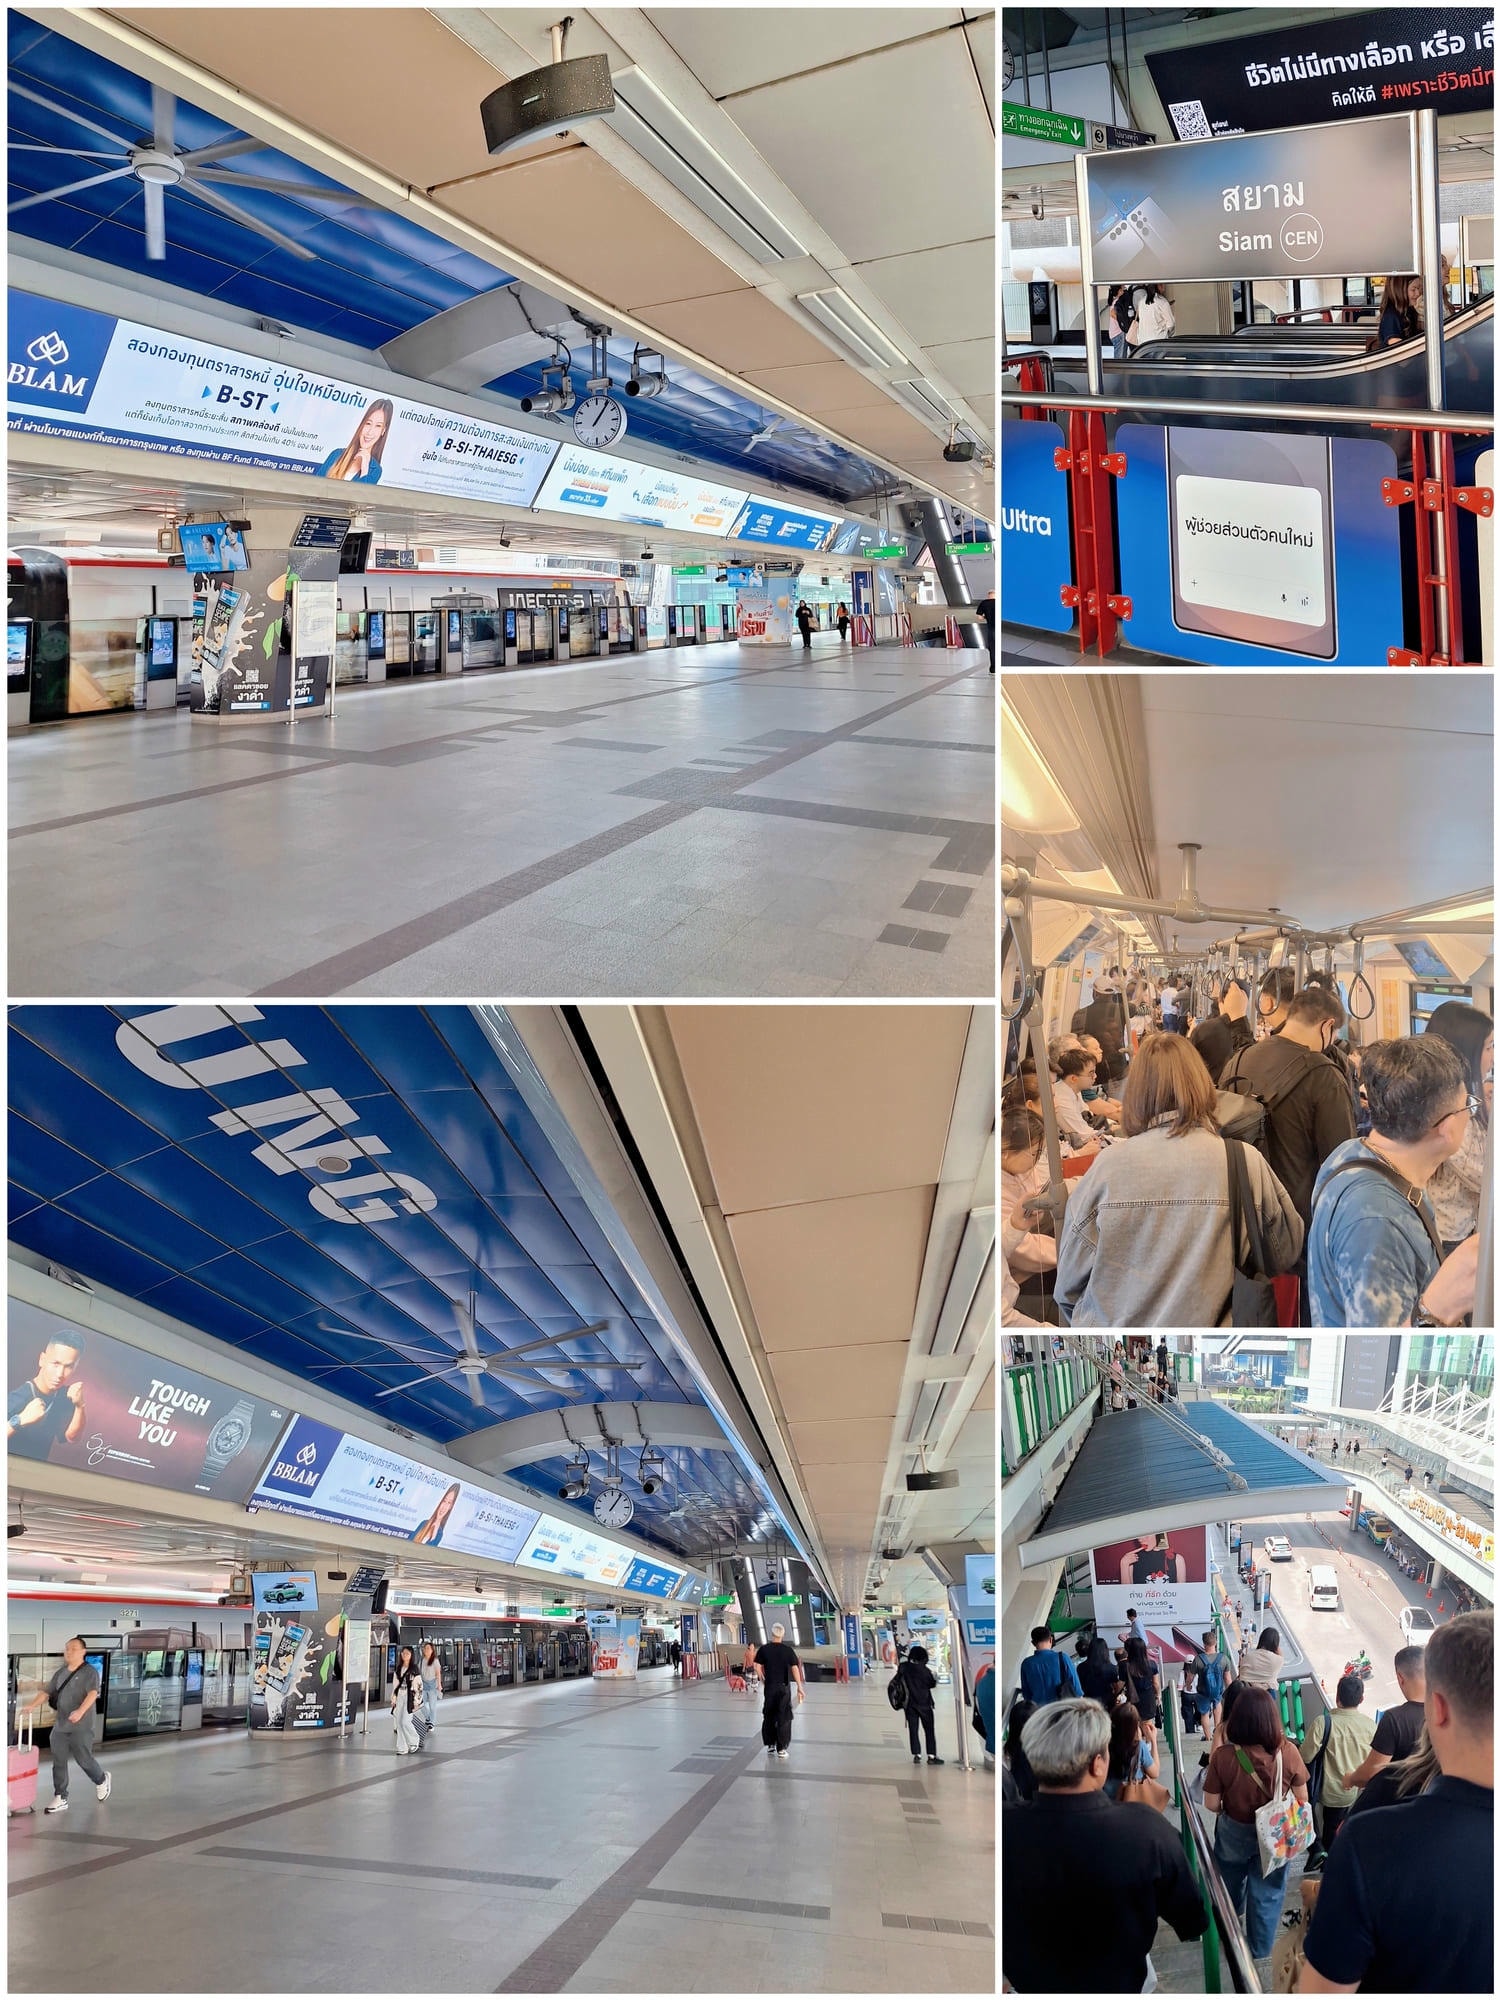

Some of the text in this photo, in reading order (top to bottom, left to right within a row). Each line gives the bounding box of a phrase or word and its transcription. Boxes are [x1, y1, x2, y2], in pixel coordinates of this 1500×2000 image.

[1245, 41, 1413, 87] ชีวิตไม่มีทางเลือก
[1421, 28, 1466, 59] หรือ
[1332, 85, 1377, 107] คิดให้ดี
[1020, 124, 1062, 139] Emergency Exit
[1096, 130, 1102, 142] 3
[1221, 178, 1304, 213] สยาม
[1218, 230, 1318, 252] Siam CEN
[127, 338, 368, 408] สองกองทุนตราสารหนี้ อุ่นใจเหมือนกัน
[216, 384, 269, 411] B-ST
[230, 416, 281, 432] สภาพคล่องดี
[169, 444, 185, 454] หรือ
[187, 449, 221, 460] ลงทุนผ่าน
[221, 452, 233, 461] BF
[233, 454, 252, 464] Fund
[252, 457, 278, 469] Trading
[291, 463, 315, 474] BBLAM
[443, 437, 518, 465] B-SI-THAIESG
[1002, 507, 1052, 536] Ultra
[1185, 515, 1314, 549] ผู้ช่วยส่วนตัวคนใหม่
[128, 1396, 175, 1425] LIKE
[148, 1378, 212, 1416] TOUGH
[138, 1420, 177, 1447] YOU
[272, 1461, 320, 1487] BBLAM
[375, 1476, 401, 1494] B-ST
[1163, 1590, 1177, 1598] ด้วย
